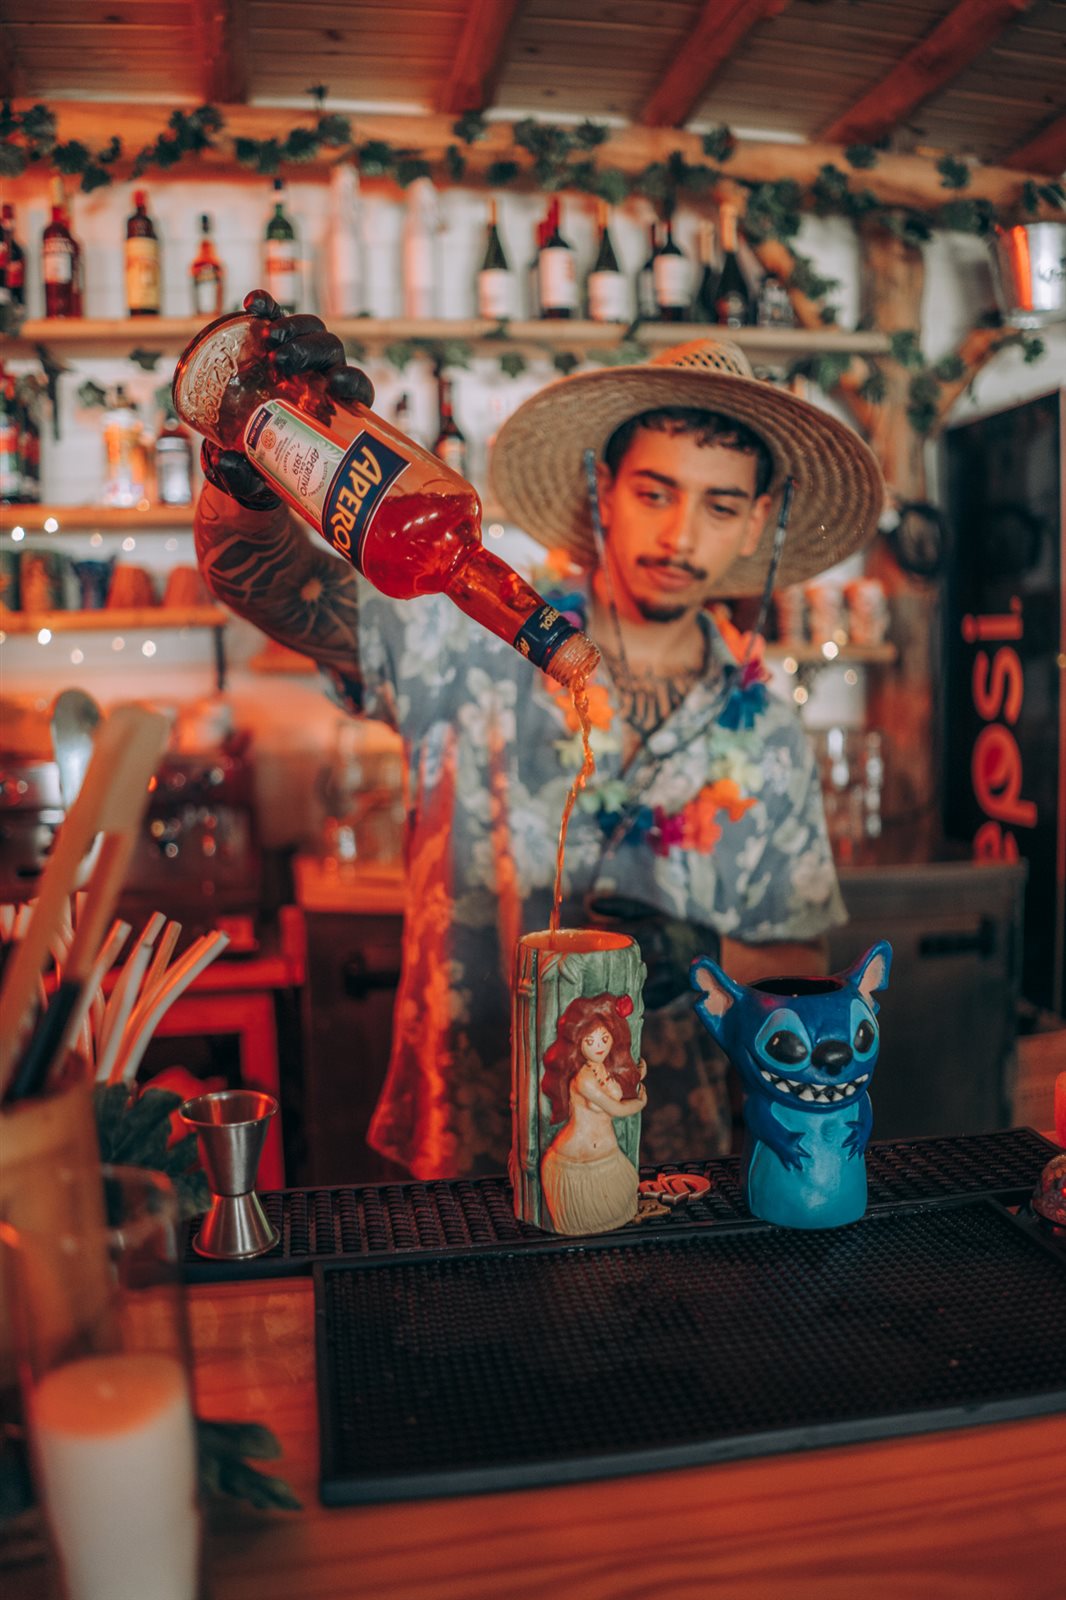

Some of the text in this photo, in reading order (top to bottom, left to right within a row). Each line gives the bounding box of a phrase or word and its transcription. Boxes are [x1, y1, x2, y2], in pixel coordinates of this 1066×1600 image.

[291, 452, 304, 476] 1919
[300, 447, 320, 496] APERITIVO
[330, 446, 382, 559] APEROL
